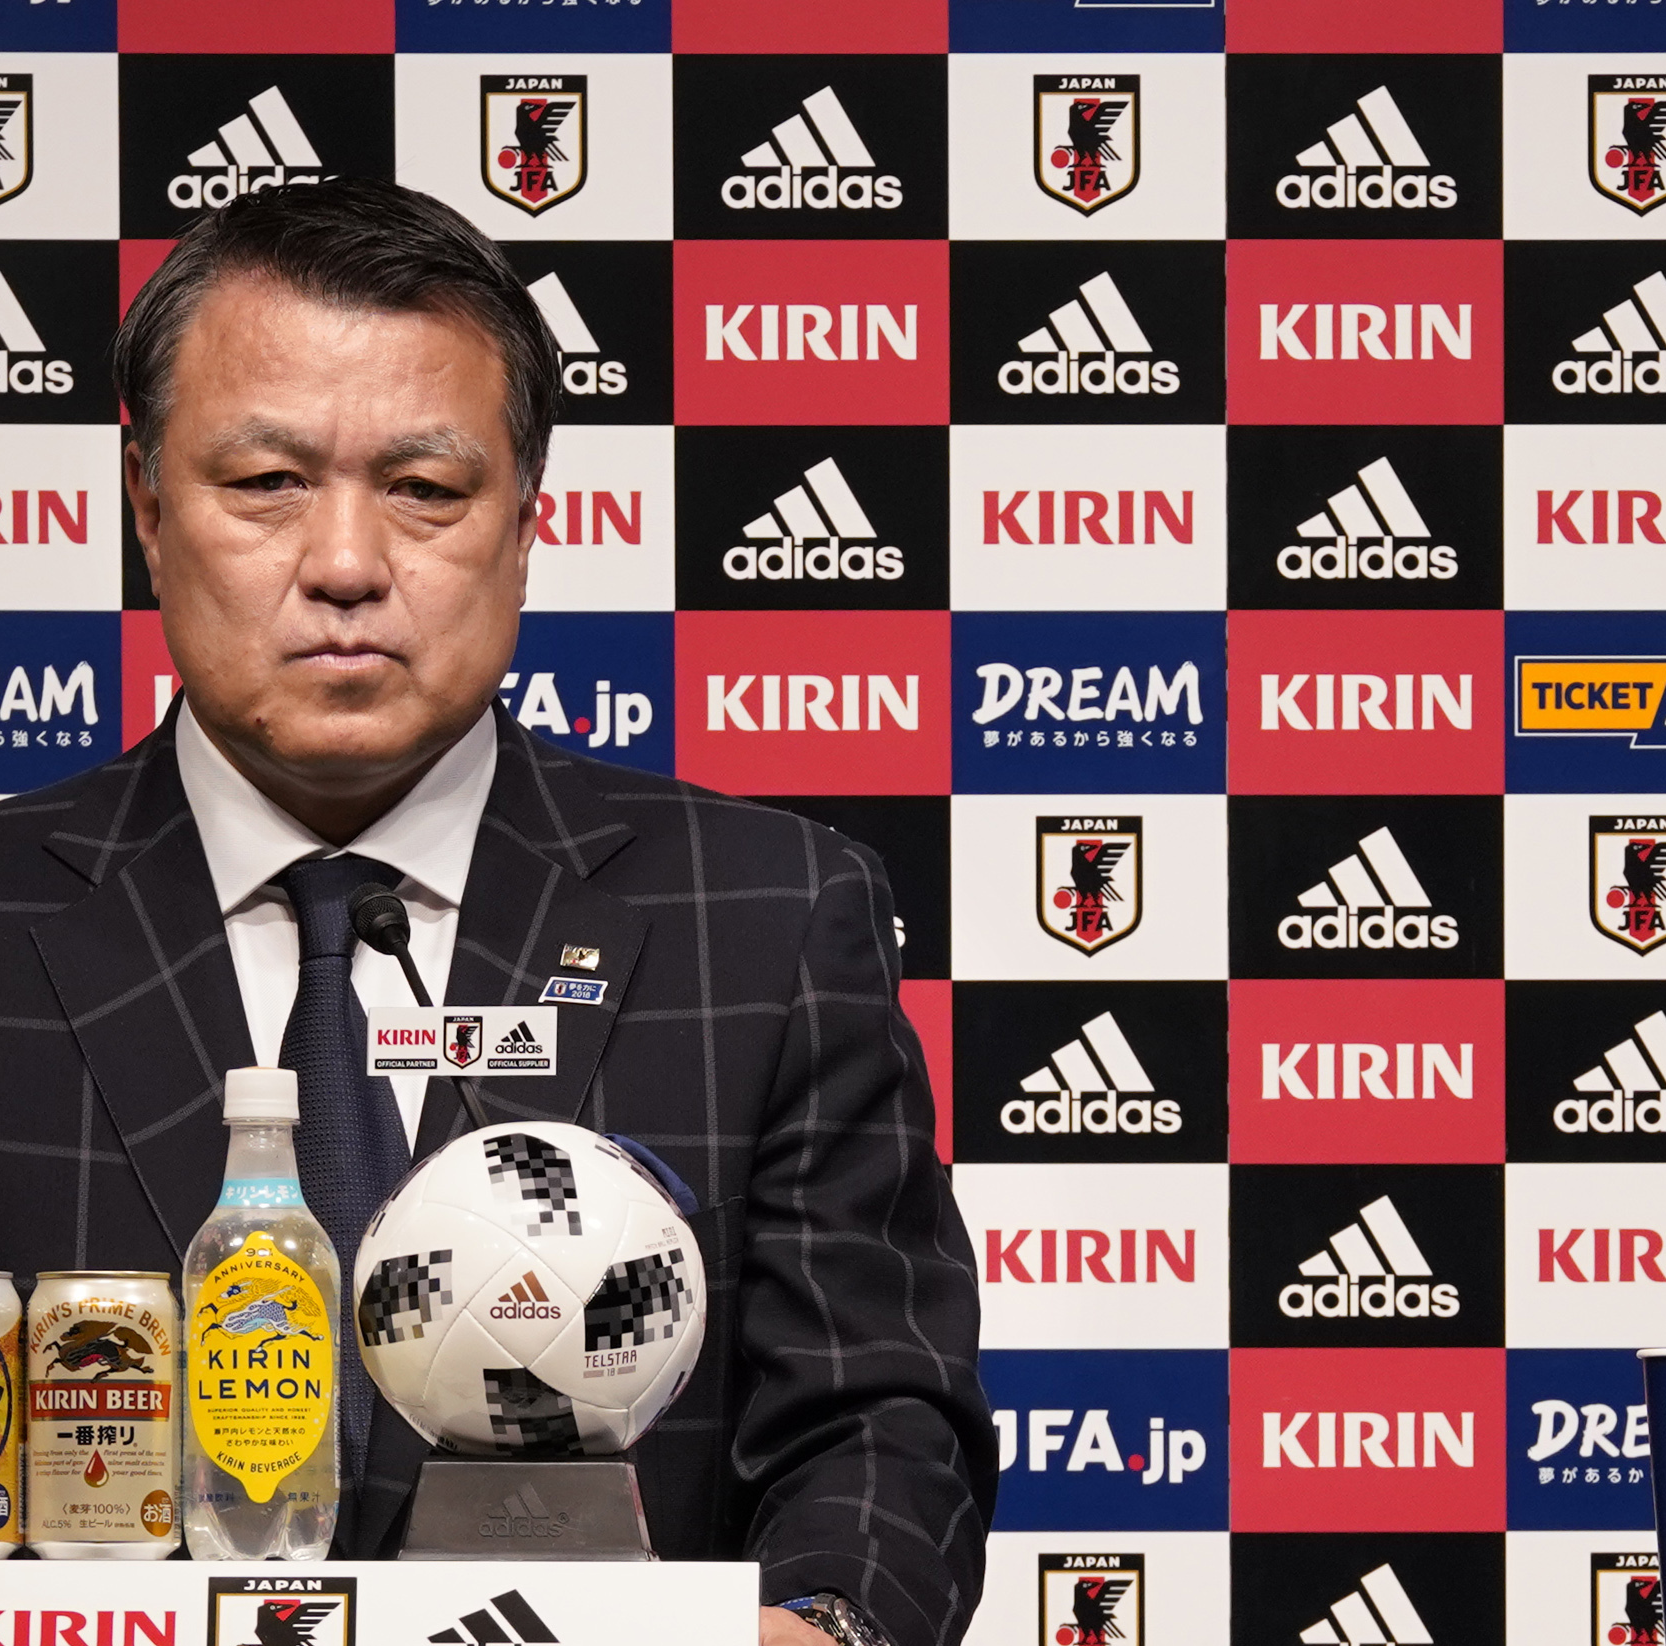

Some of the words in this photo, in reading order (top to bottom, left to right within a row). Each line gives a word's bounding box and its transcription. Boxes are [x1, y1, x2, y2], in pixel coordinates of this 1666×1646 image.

[1059, 78, 1115, 89] JAPAN
[722, 166, 902, 209] adidas
[1062, 171, 1110, 191] JFA
[706, 305, 917, 360] KIRIN
[1260, 304, 1471, 360] KIRIN
[984, 491, 1193, 544] KIRIN
[972, 661, 1203, 725] DREAM
[1261, 675, 1472, 730] KIRIN
[1532, 682, 1654, 711] TICKET
[983, 731, 1197, 747] 夢があるから強くなる
[1618, 912, 1666, 932] JFA
[377, 1029, 436, 1045] KIRIN
[495, 1042, 543, 1054] adidas
[377, 1060, 405, 1068] OFFICIAL
[405, 1060, 436, 1068] PARTNER
[489, 1060, 518, 1068] OFFICIAL
[519, 1060, 549, 1068] SUPPLIER
[1001, 1090, 1182, 1133] adidas
[226, 1185, 299, 1199] キリンレモン
[985, 1230, 1195, 1283] KIRIN
[214, 1261, 305, 1284] ANNIVERSARY
[490, 1301, 561, 1320] adidas
[79, 1297, 134, 1320] PRIME
[138, 1311, 172, 1357] BREW
[209, 1349, 310, 1369] KIRIN
[584, 1350, 638, 1367] TELSTAR
[199, 1379, 320, 1399] LEMON
[36, 1389, 97, 1410] KIRIN
[106, 1390, 163, 1410] BEER
[57, 1426, 134, 1446] 一番搾り
[991, 1410, 1207, 1485] JFA.jp
[216, 1451, 245, 1471] KIRIN
[250, 1452, 302, 1473] BEVERAGE
[479, 1517, 563, 1537] adidas
[243, 1580, 322, 1591] JAPAN
